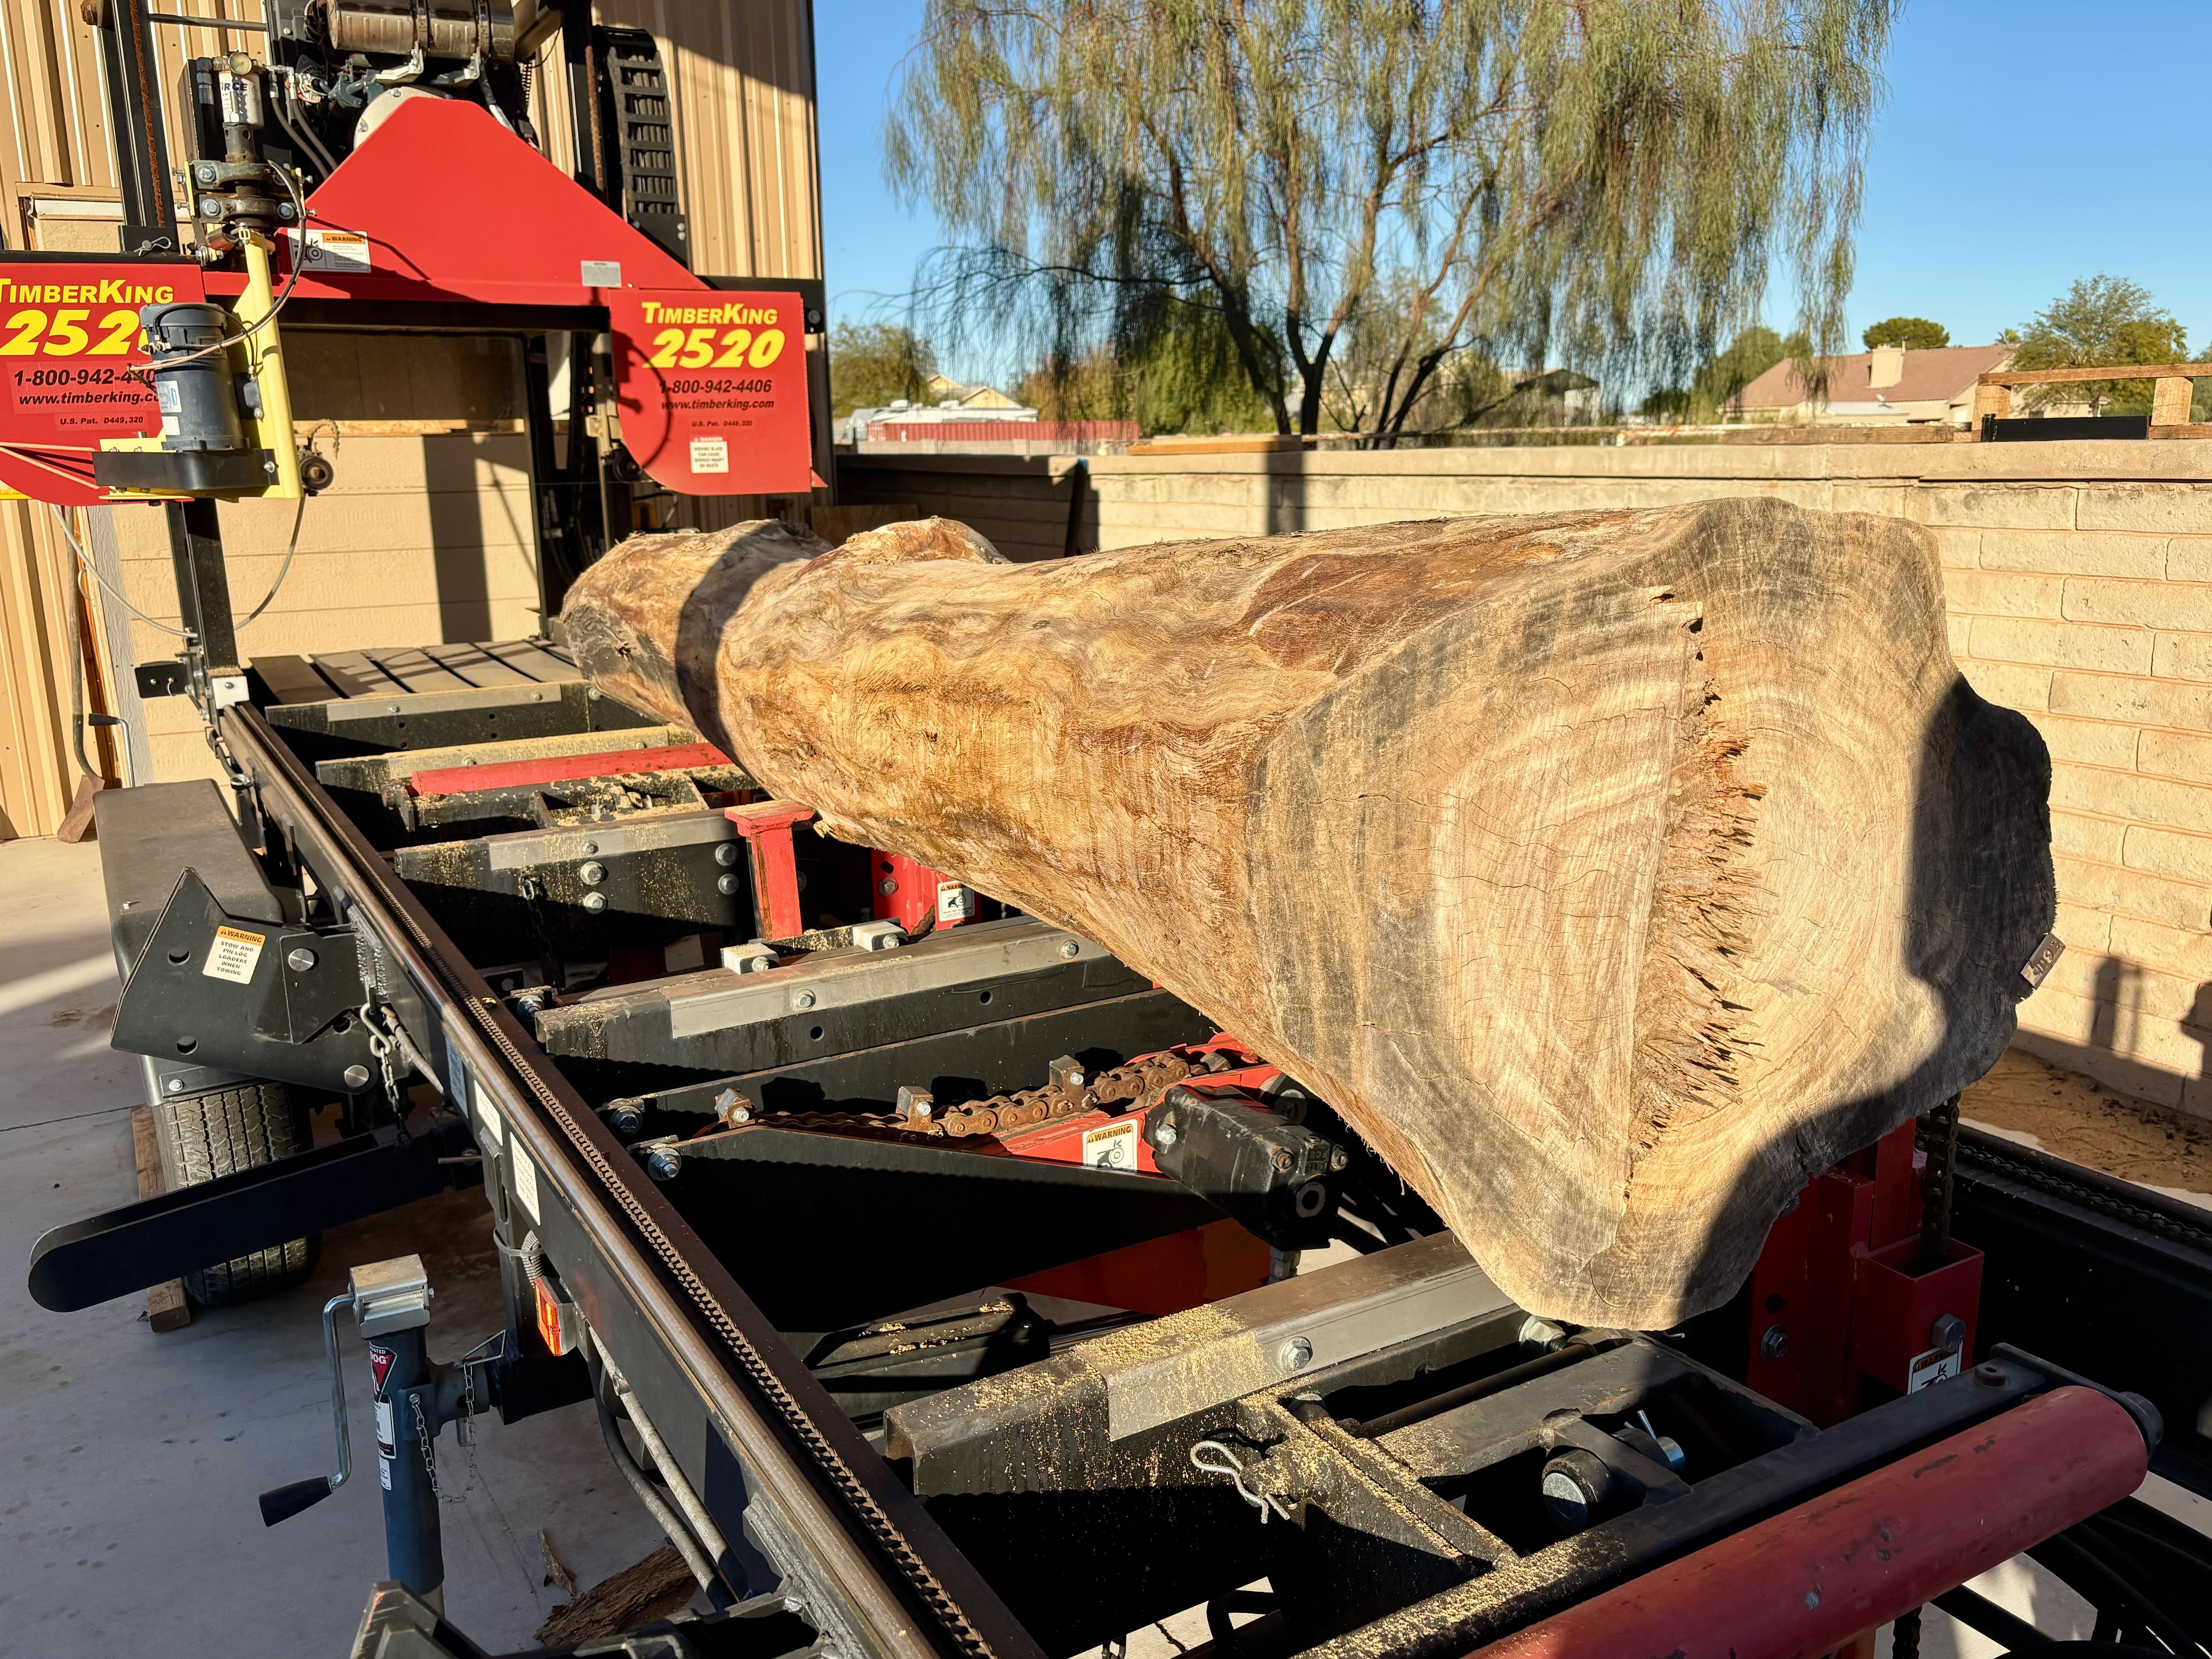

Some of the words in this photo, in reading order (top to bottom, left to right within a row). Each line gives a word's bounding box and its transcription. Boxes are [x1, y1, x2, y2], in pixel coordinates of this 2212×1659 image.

[221, 82, 248, 91] RCE
[641, 302, 778, 325] TIMBERKING
[0, 309, 150, 356] 252
[642, 328, 785, 369] 2520
[14, 369, 155, 386] 1-800-942-440
[660, 380, 773, 393] 1-800-942-4406
[662, 399, 774, 410] www.timberking.com
[227, 930, 263, 943] WARNING
[219, 954, 247, 964] LOADERS
[217, 967, 241, 975] TOWING
[1095, 1126, 1131, 1141] WARNING
